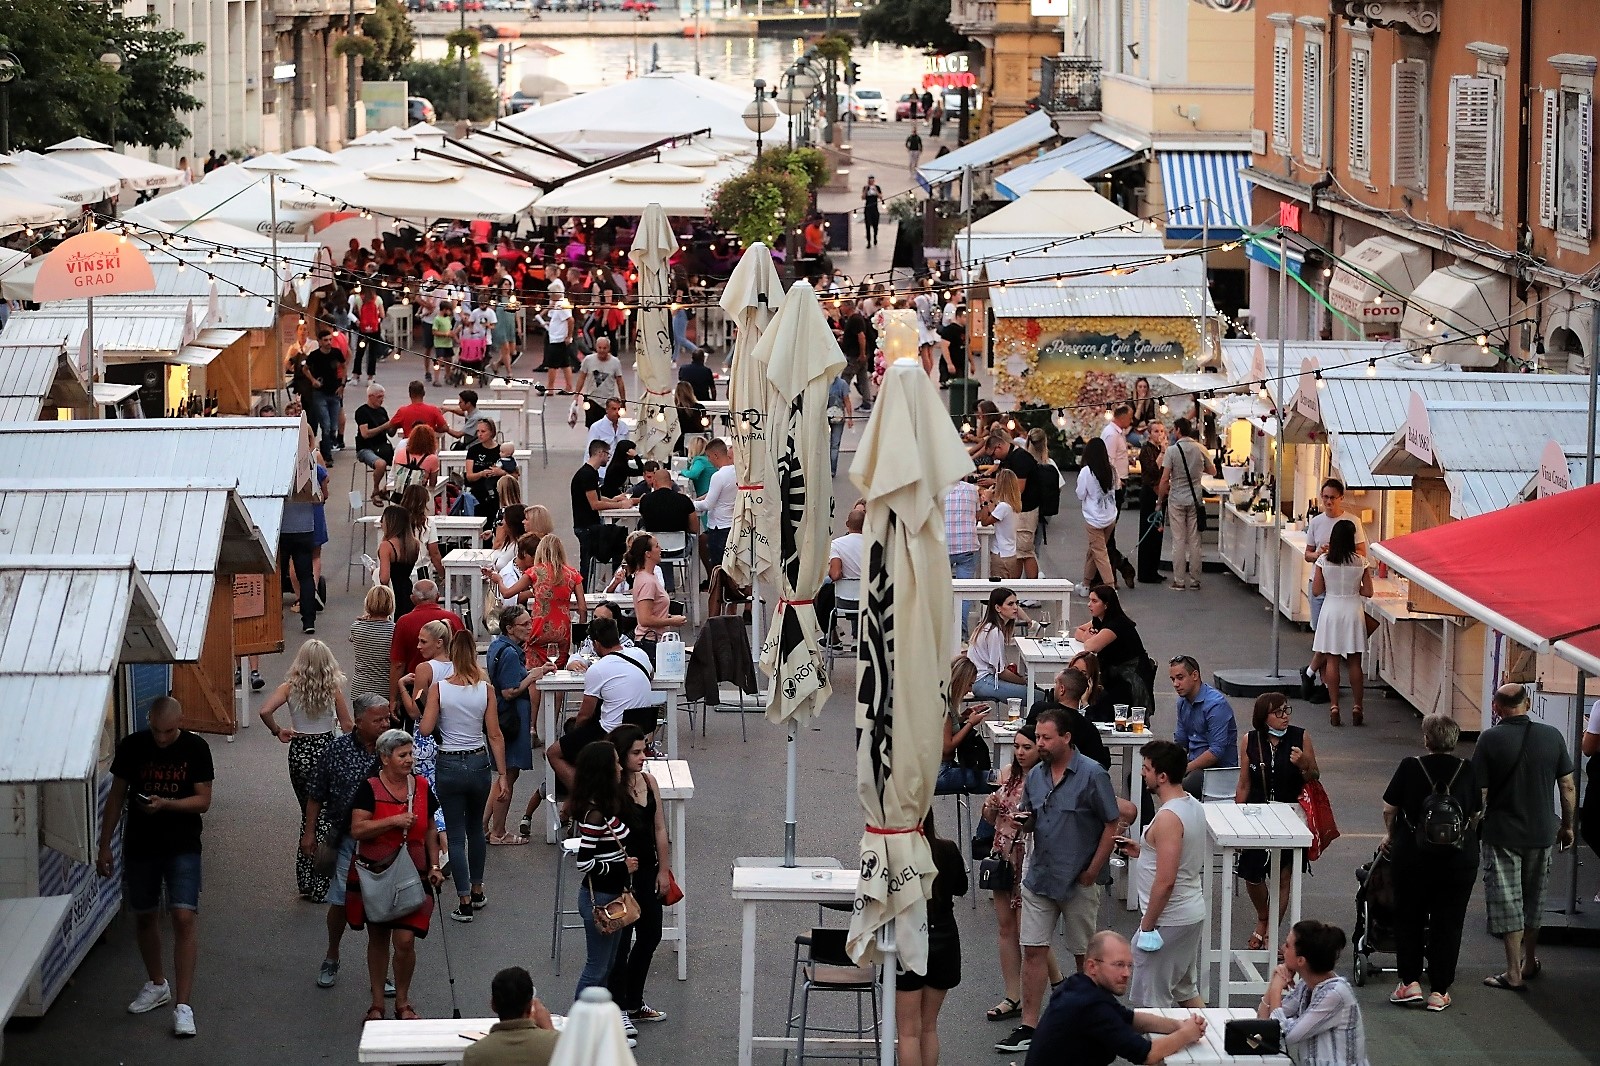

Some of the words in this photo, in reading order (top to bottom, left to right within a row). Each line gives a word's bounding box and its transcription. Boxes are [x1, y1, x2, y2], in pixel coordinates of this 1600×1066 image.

[256, 220, 296, 235] CocaCola
[66, 258, 121, 274] VINSKI
[74, 273, 114, 287] GRAD
[1363, 306, 1400, 316] FOTO
[1047, 339, 1096, 354] Prosecco
[1111, 339, 1130, 357] Gin
[1134, 340, 1172, 357] Garden
[144, 782, 179, 793] GRAD
